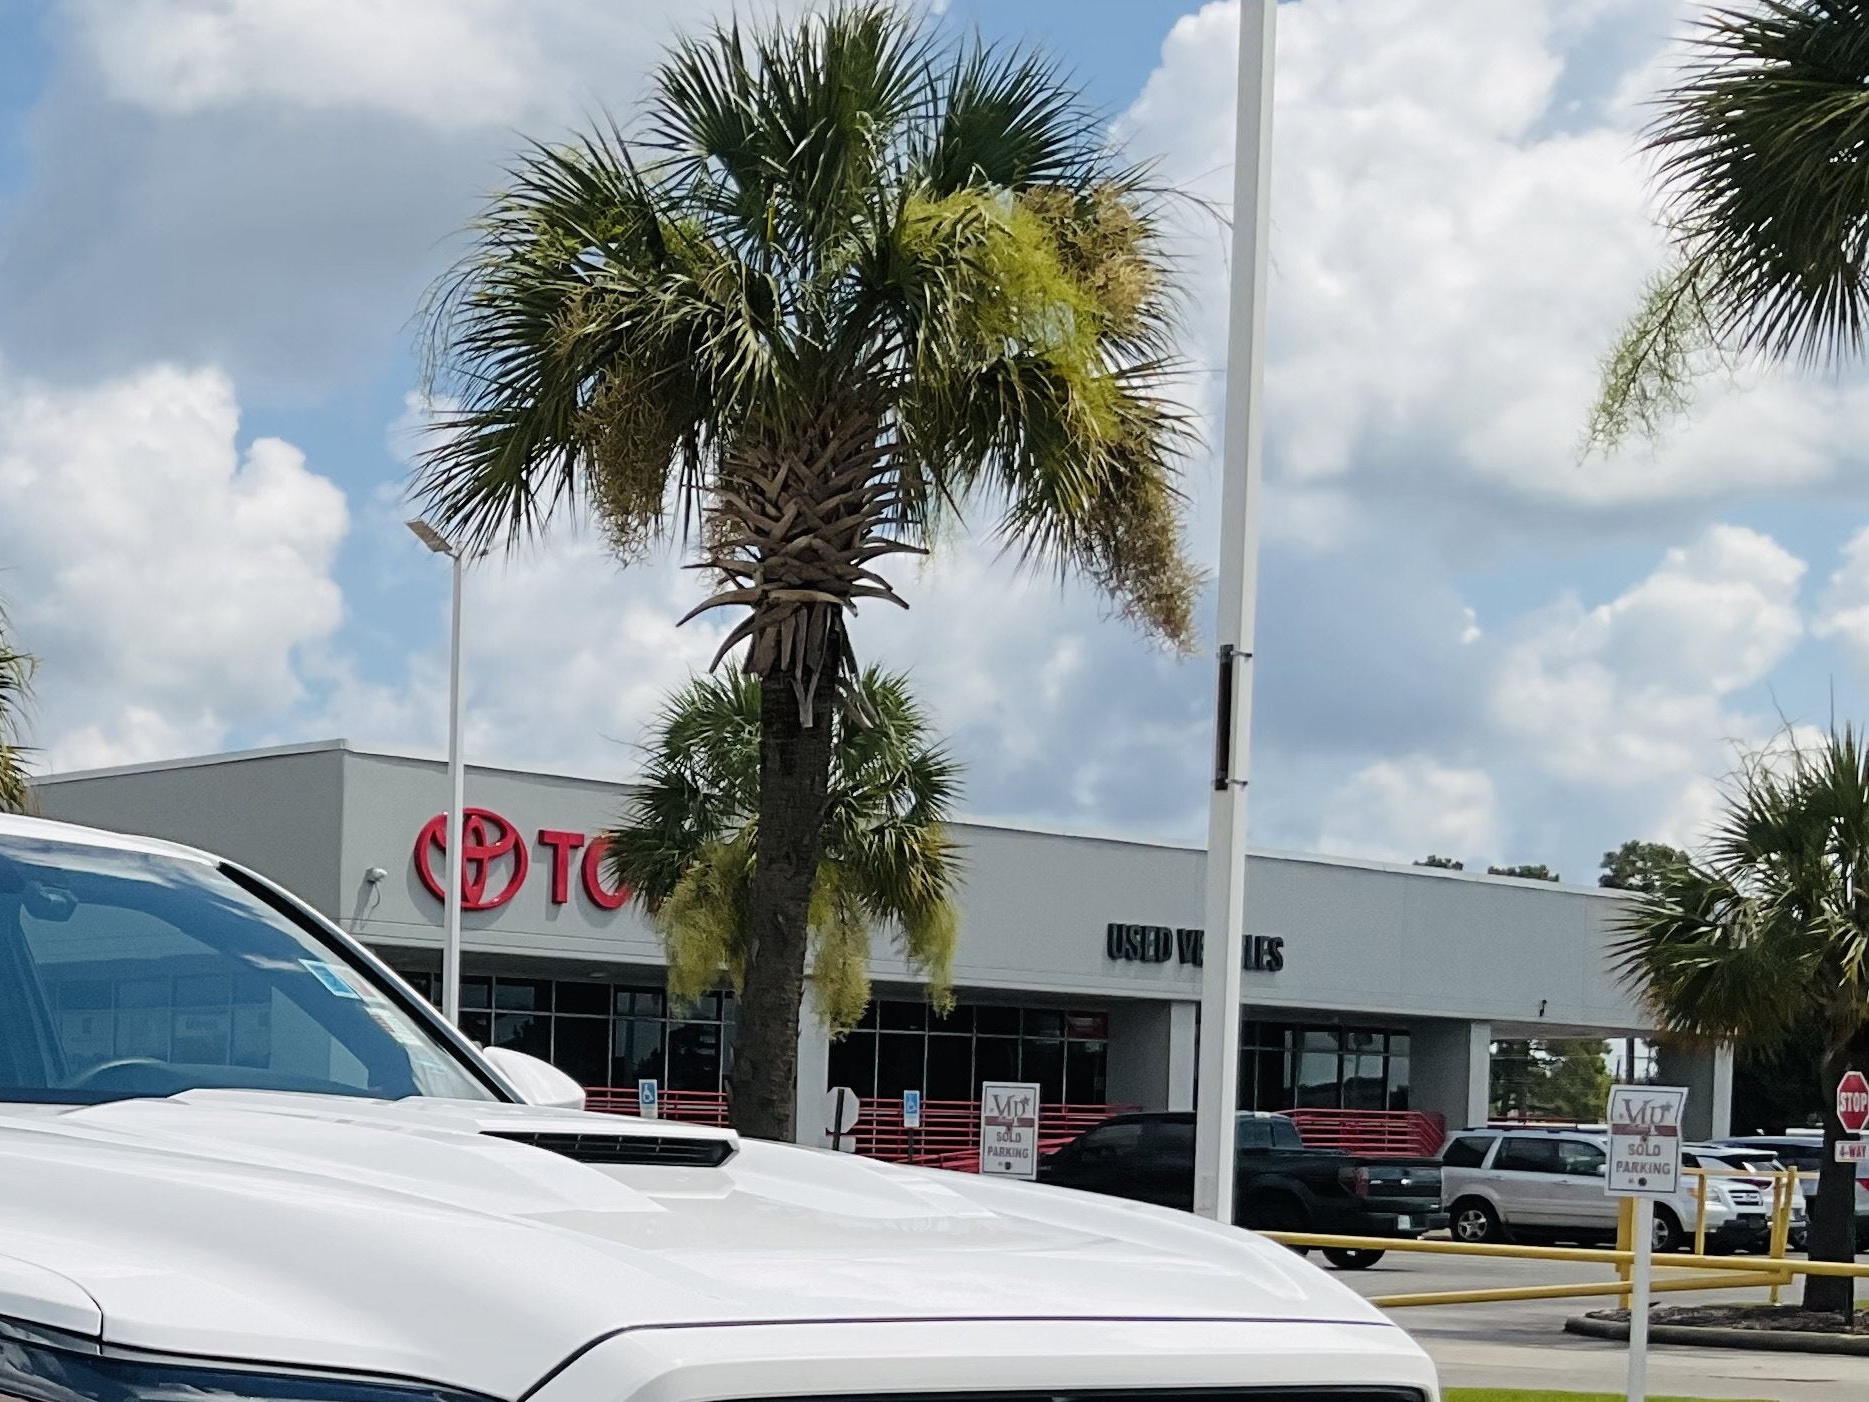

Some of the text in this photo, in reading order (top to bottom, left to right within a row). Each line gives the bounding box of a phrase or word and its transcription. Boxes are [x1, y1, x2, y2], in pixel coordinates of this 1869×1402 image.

[1107, 923, 1173, 963] USED
[1840, 1091, 1868, 1112] STOP
[996, 1131, 1022, 1143] SOLD
[987, 1146, 1029, 1159] PARKING
[1628, 1143, 1661, 1156] SOLD
[1839, 1144, 1867, 1158] 4-WAY
[1615, 1161, 1671, 1175] PARKING
